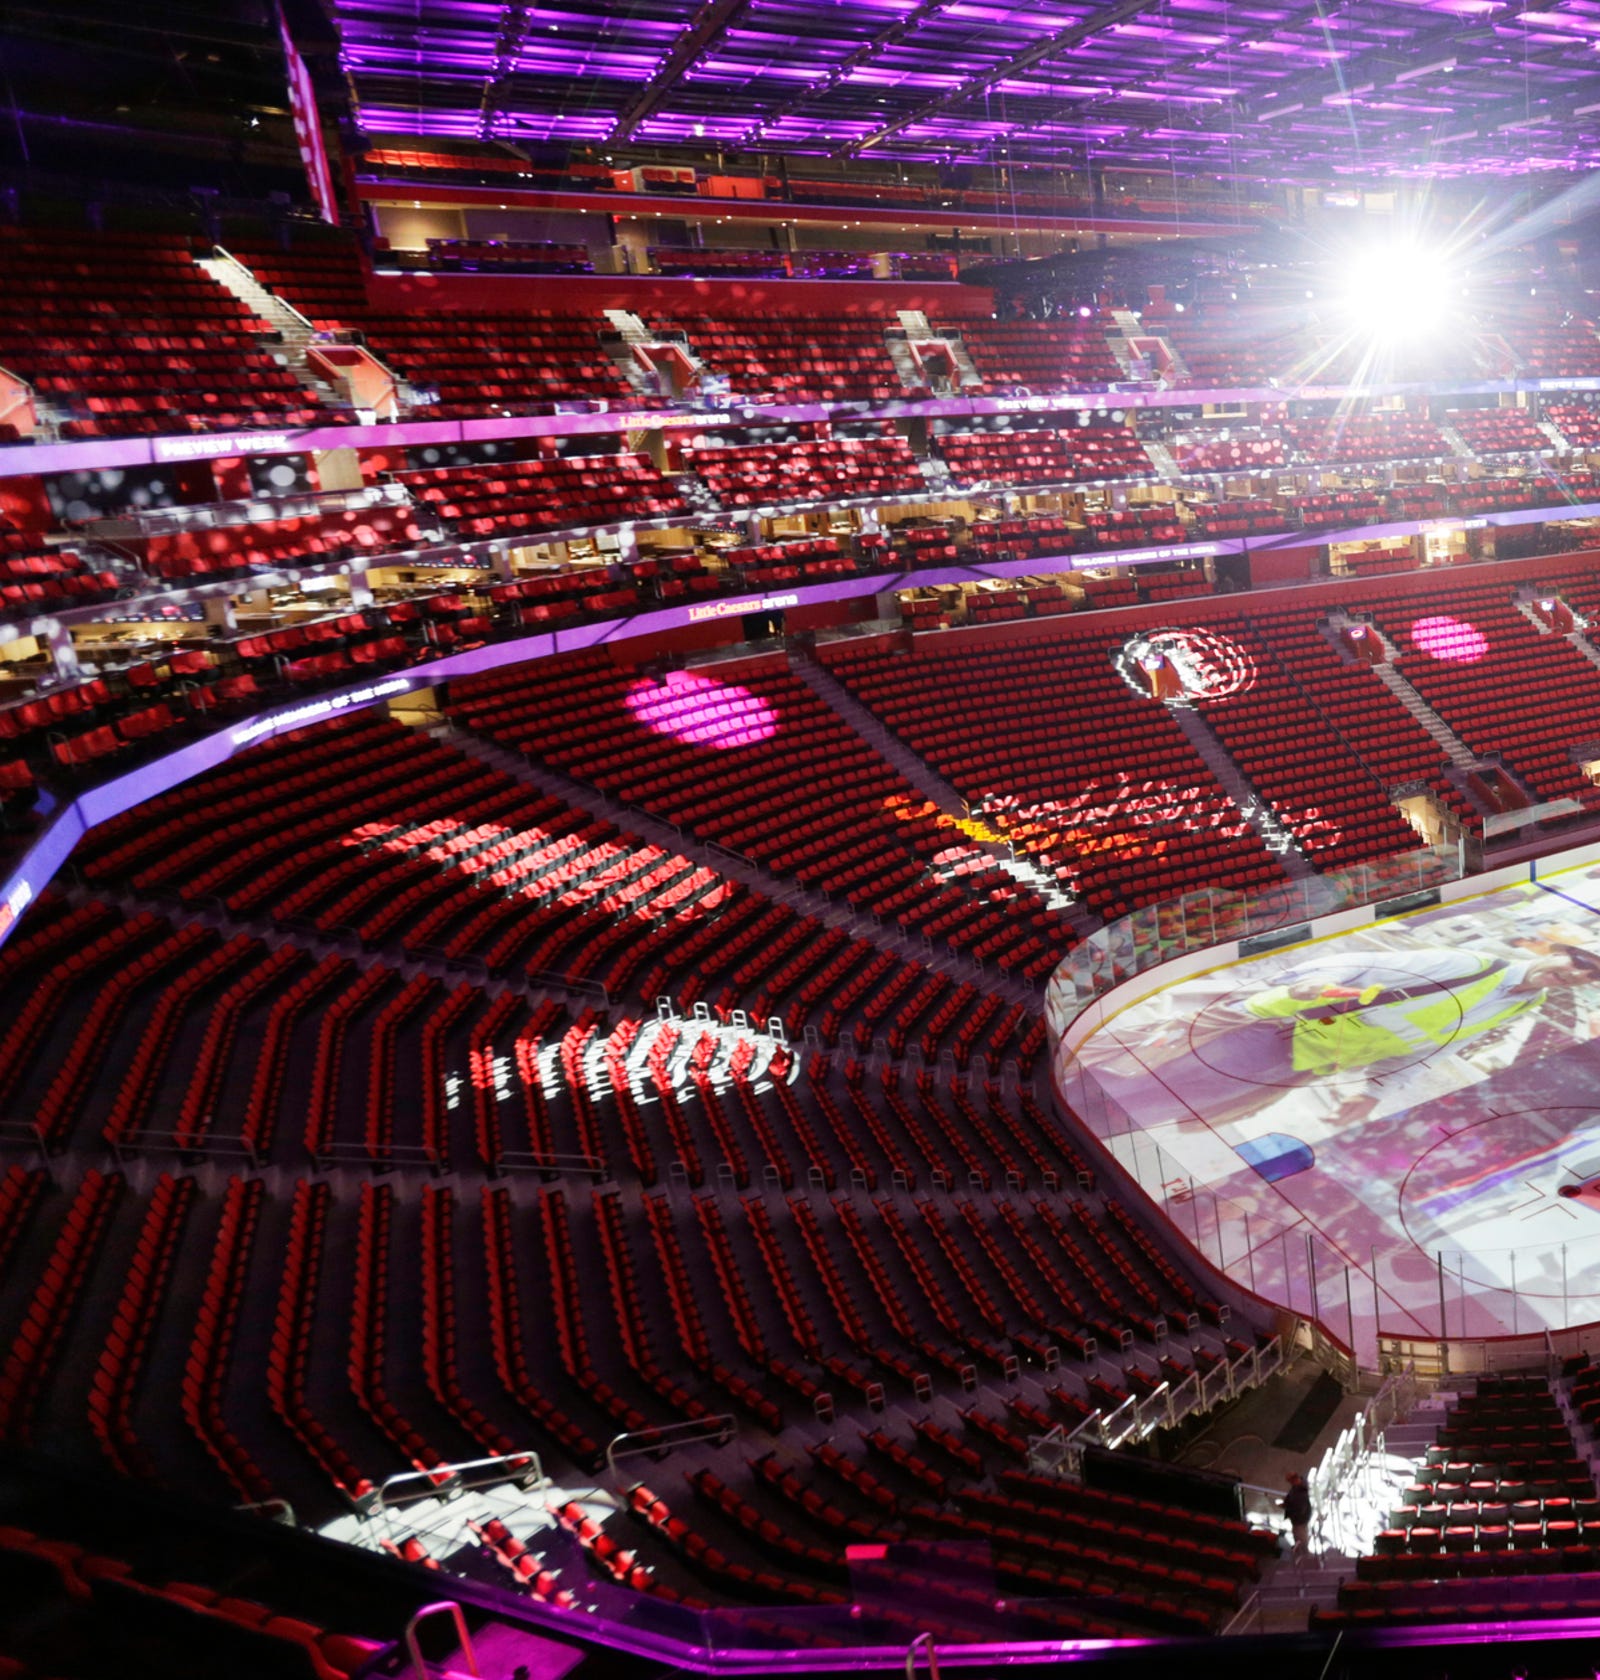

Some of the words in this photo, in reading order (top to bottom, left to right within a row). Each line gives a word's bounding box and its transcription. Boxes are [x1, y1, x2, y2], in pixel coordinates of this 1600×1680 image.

[161, 439, 233, 457] PREVIEW
[234, 435, 287, 450] WEEK
[1071, 555, 1116, 567] WELCOME
[1117, 551, 1157, 563] MEMBERS
[1158, 550, 1171, 558] OF
[1172, 547, 1189, 556] THE
[1190, 546, 1216, 555] MEDIA
[688, 605, 717, 621] Little
[717, 599, 762, 615] Caesars
[762, 594, 798, 609] arena
[331, 695, 350, 708] OF
[350, 688, 375, 702] THE
